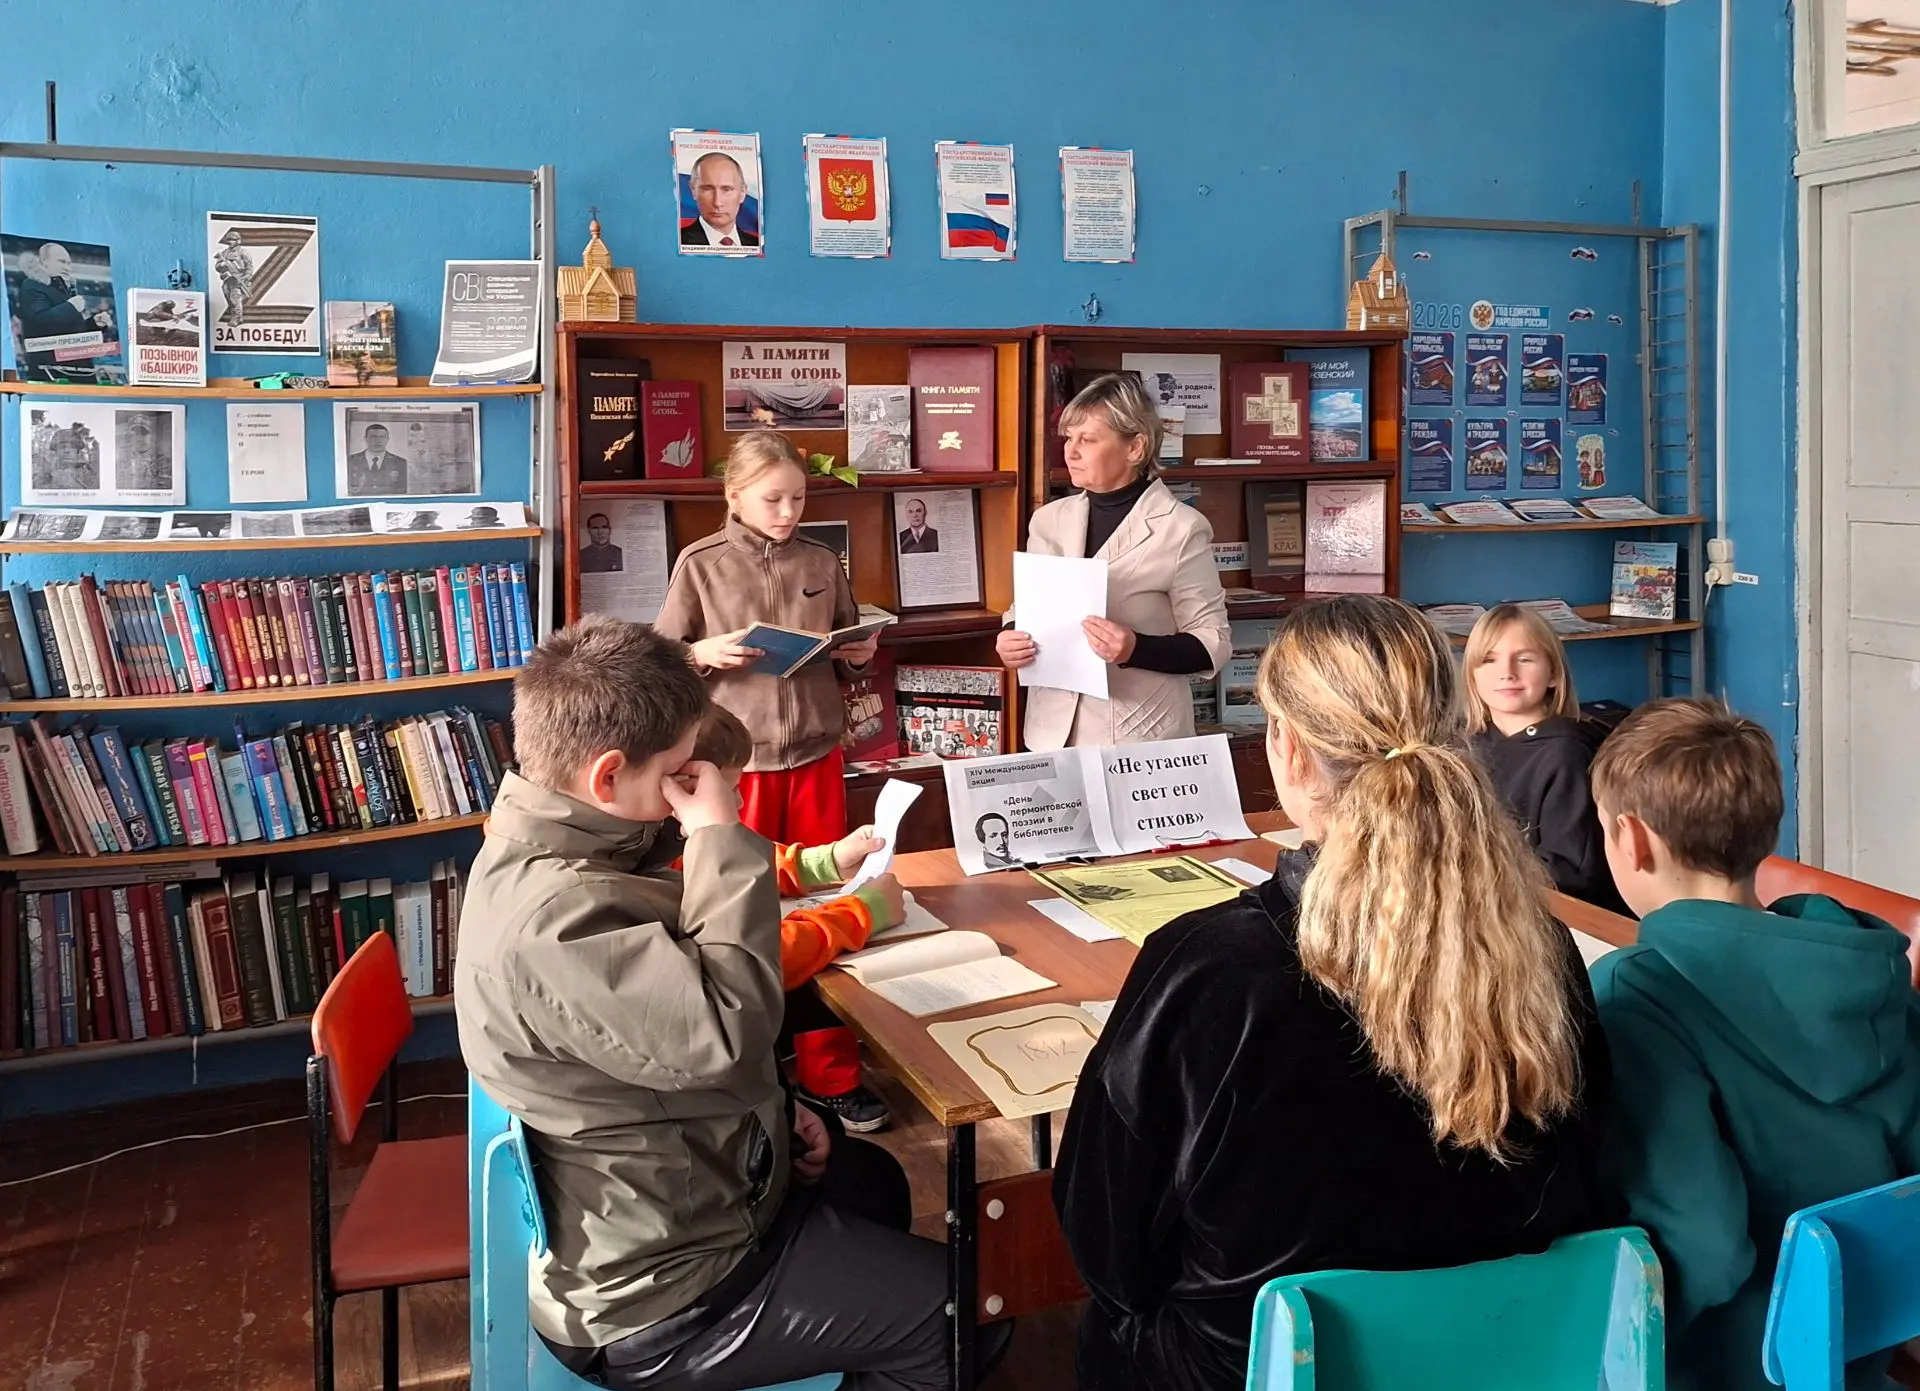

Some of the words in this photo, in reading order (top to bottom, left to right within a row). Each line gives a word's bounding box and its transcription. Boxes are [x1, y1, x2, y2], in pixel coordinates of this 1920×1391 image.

[1413, 303, 1462, 329] 2026
[1509, 307, 1541, 317] ЕДИНСТВА
[1495, 317, 1522, 326] НАРОДОВ
[1523, 318, 1549, 327] РОССИИ
[57, 334, 101, 346] ПРЕЗИДЕНТ
[216, 328, 235, 342] ЗА
[241, 329, 307, 345] ПОБЕДУ!
[140, 348, 198, 362] ПОЗЫВНОЙ
[741, 346, 754, 360] А
[763, 348, 830, 360] ПАМЯТИ
[140, 362, 199, 375] «БАШКИР»
[1311, 362, 1327, 370] РАЙ
[1328, 361, 1349, 370] МОЙ
[730, 367, 782, 380] ВЕЧЕН
[791, 367, 842, 380] ОГОНЬ
[1311, 371, 1355, 379] НЗЕНСКИЙ
[921, 386, 945, 394] КНИГА
[948, 386, 980, 394] ПАМЯТИ
[1184, 384, 1216, 392] родной,
[1221, 553, 1245, 564] край!
[969, 769, 983, 777] XIV
[984, 761, 1050, 775] Международная
[1108, 757, 1142, 775] «Не
[1148, 752, 1209, 776] угаснет
[150, 754, 169, 788] ДЕРЕВУ
[366, 765, 384, 810] БОТАНИКА
[971, 777, 996, 787] акция
[1131, 784, 1168, 802] свет
[1173, 783, 1199, 799] его
[1003, 795, 1033, 807] «День
[1010, 800, 1083, 817] лермонтовской
[165, 801, 182, 835] РЕЗЬБА
[1012, 817, 1046, 828] поэзии
[1137, 811, 1205, 831] стихов»
[1013, 825, 1075, 840] библиотеке»
